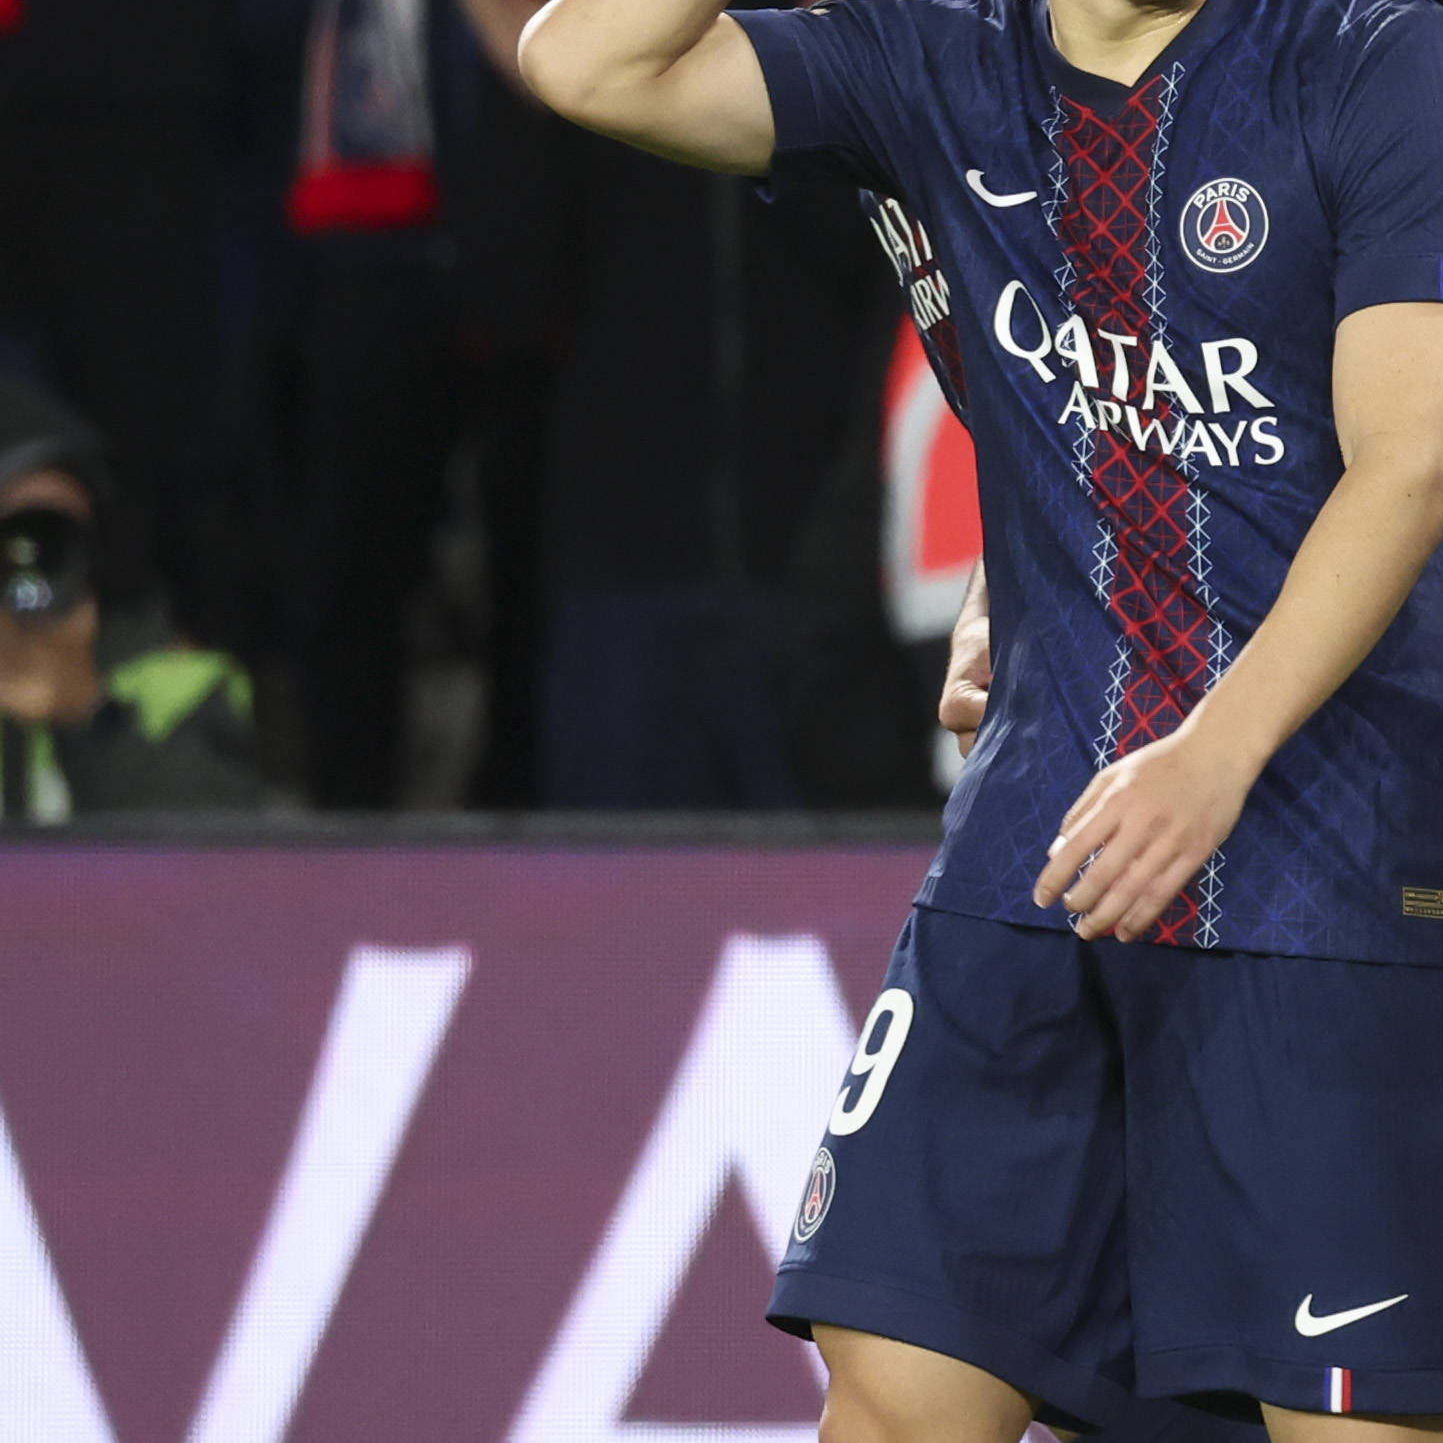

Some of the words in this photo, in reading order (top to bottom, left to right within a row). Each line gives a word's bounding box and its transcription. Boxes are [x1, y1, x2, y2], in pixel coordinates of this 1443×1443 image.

[1193, 182, 1251, 209] PARIS
[993, 280, 1276, 414] QATAR
[828, 988, 914, 1136] 9
